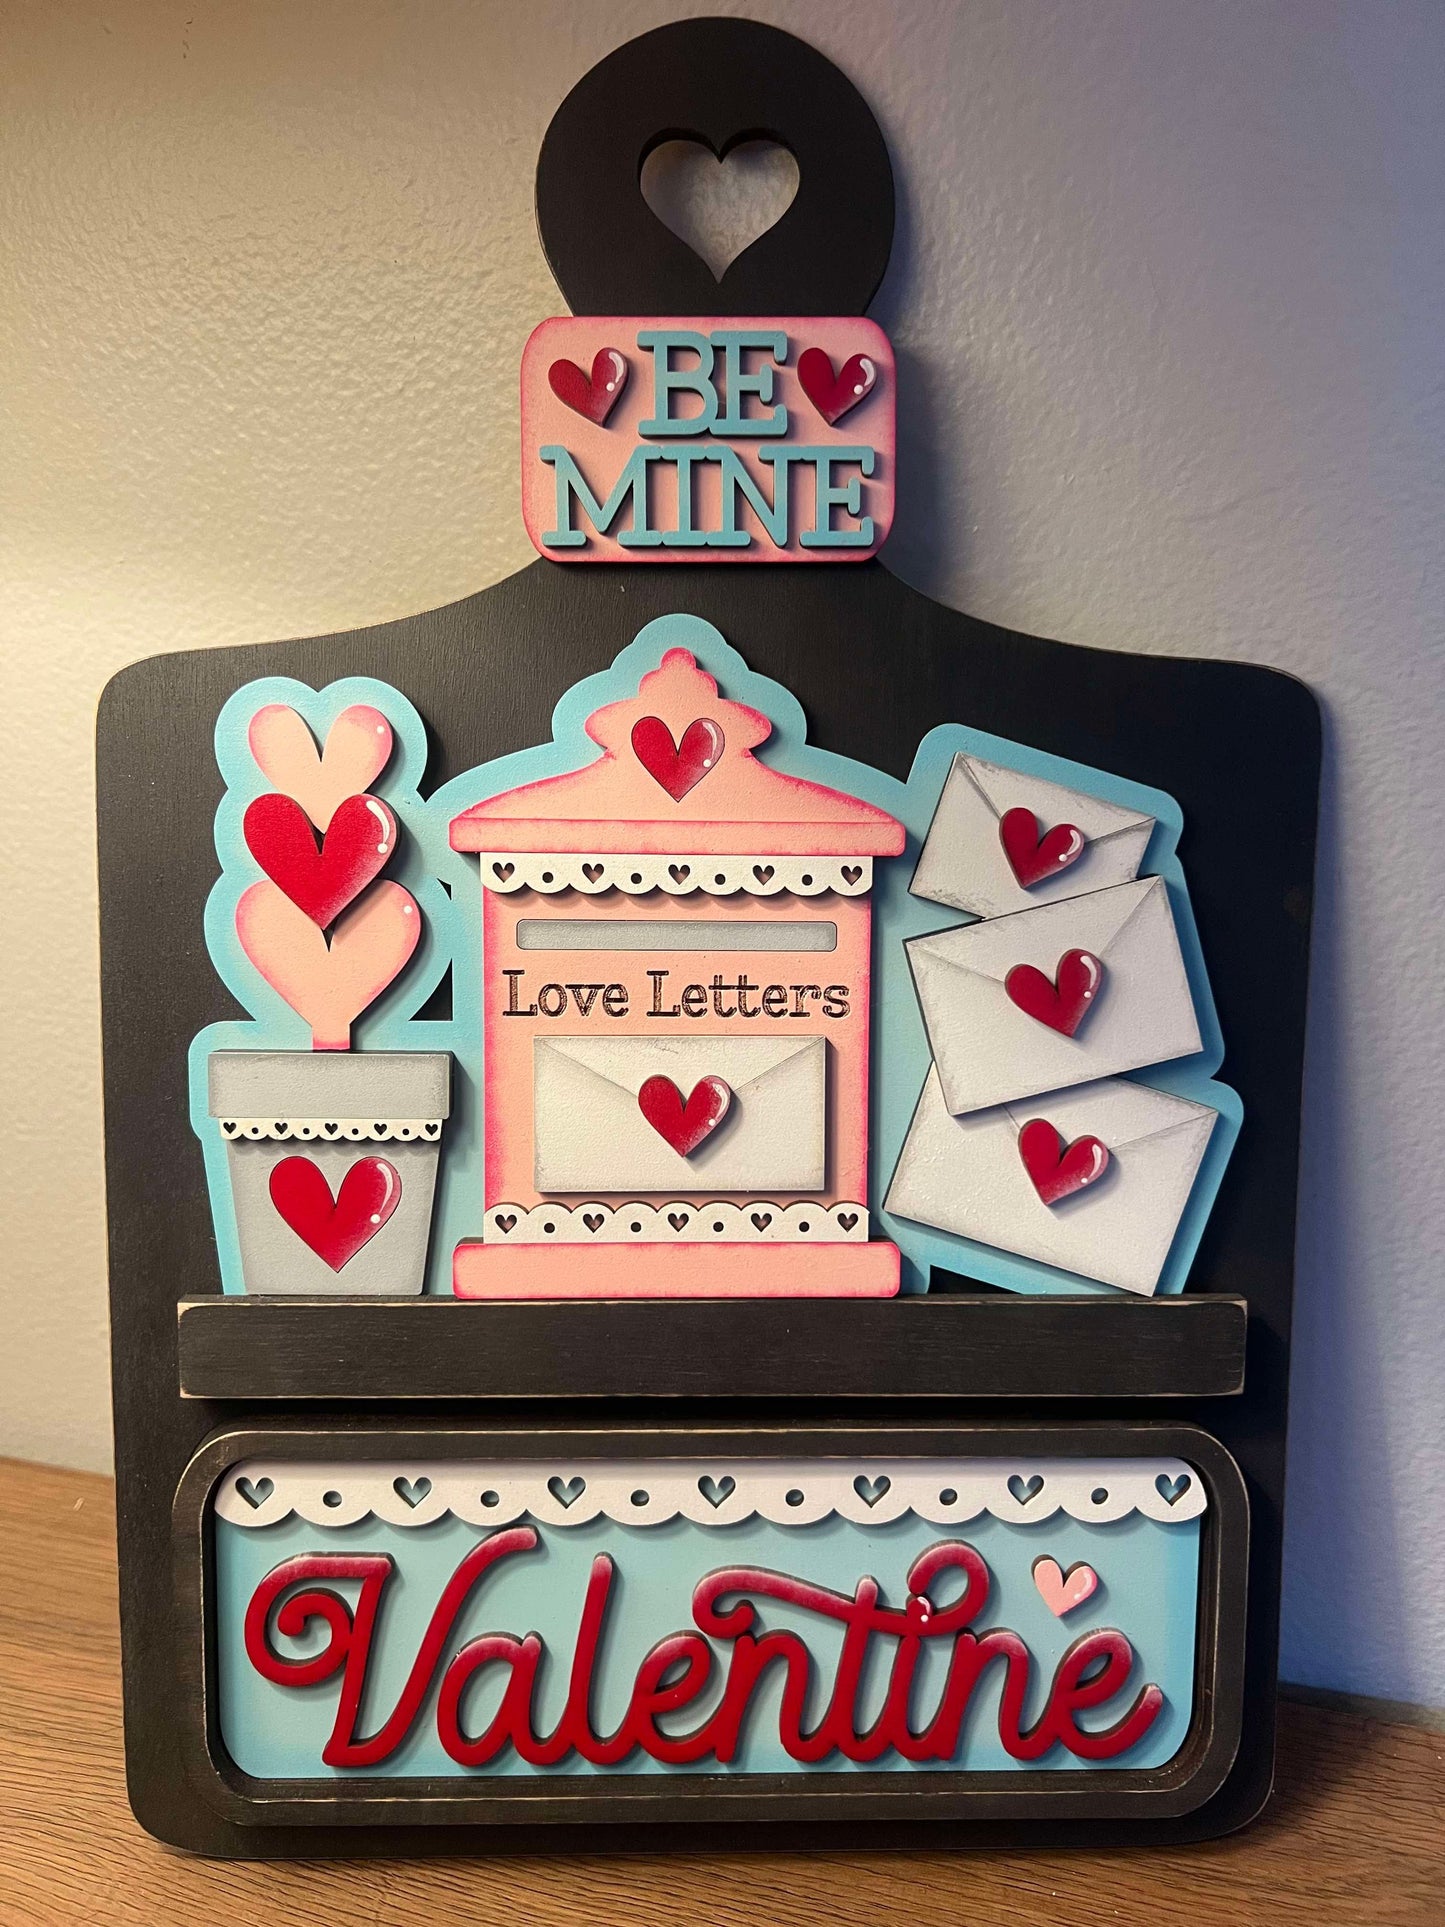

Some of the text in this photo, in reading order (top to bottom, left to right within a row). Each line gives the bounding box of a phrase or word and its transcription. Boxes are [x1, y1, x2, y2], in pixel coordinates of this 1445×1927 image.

[637, 330, 788, 437] BE
[541, 446, 875, 547] MINE
[502, 969, 850, 1018] Love Letters
[244, 1525, 1162, 1766] Valentine
